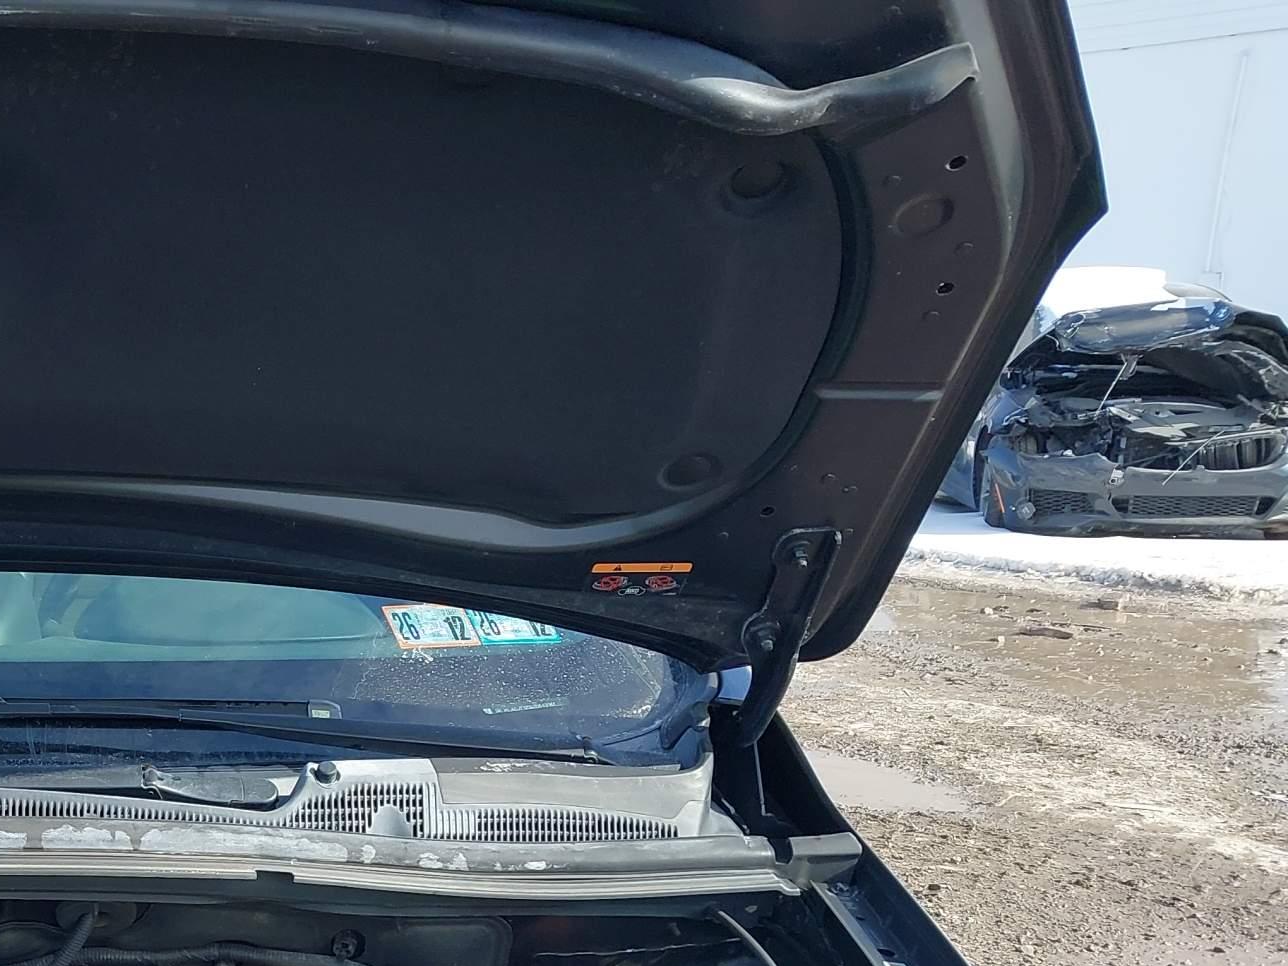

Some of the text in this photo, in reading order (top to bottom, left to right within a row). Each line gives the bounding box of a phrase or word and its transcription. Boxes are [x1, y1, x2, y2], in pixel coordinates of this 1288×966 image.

[392, 612, 472, 641] 26 12
[473, 609, 501, 636] 26
